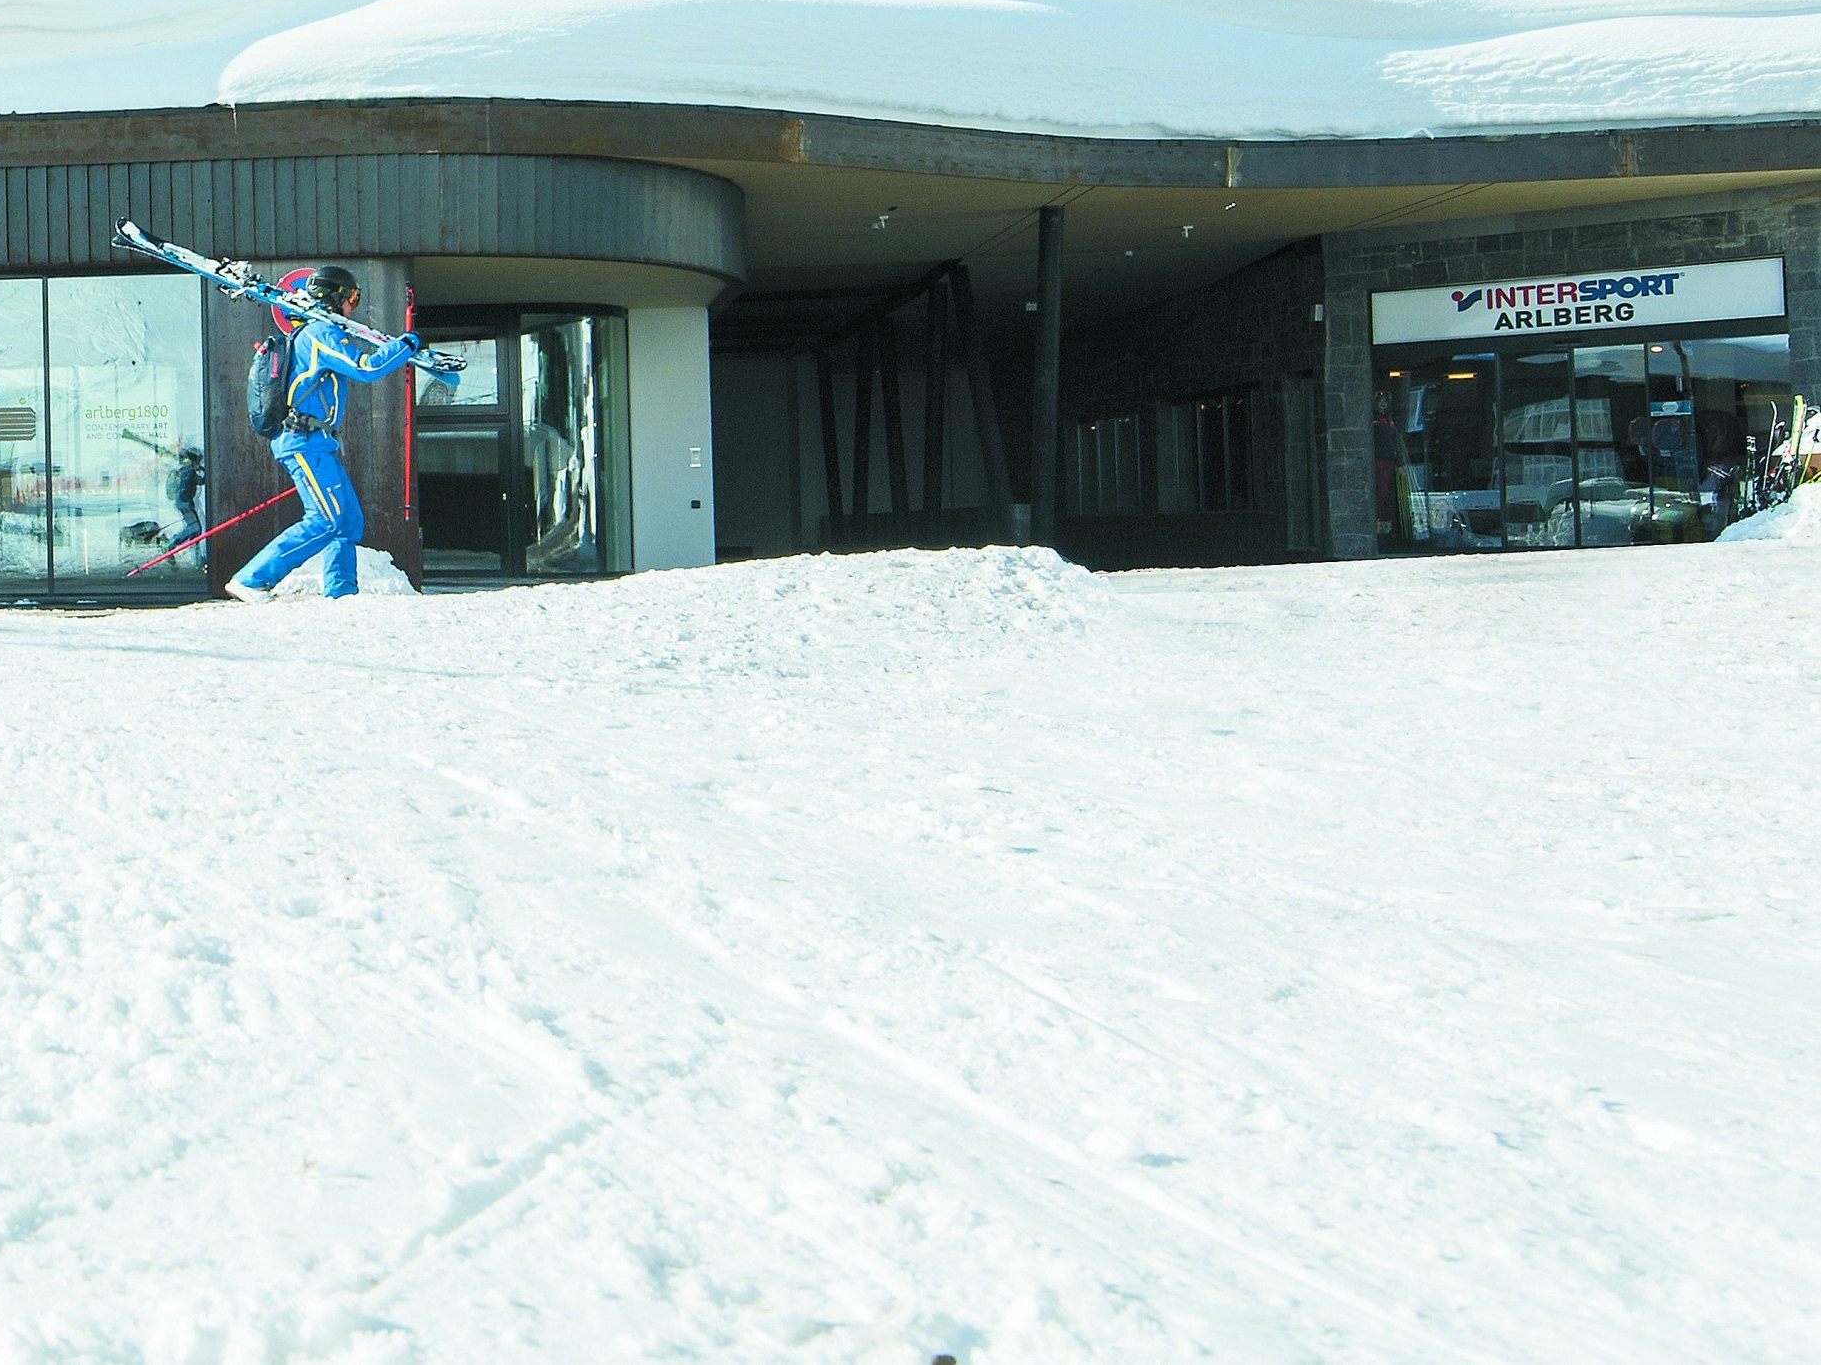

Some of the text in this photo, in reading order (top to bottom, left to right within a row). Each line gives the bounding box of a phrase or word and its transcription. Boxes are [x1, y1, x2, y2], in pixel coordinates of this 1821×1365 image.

[1486, 272, 1681, 310] INTERSPORT
[1494, 302, 1635, 331] ARLBERG
[85, 405, 169, 420] arlberg1800
[85, 422, 150, 431] CONTEMPORARY
[86, 432, 103, 440] AND
[148, 431, 168, 439] HALL
